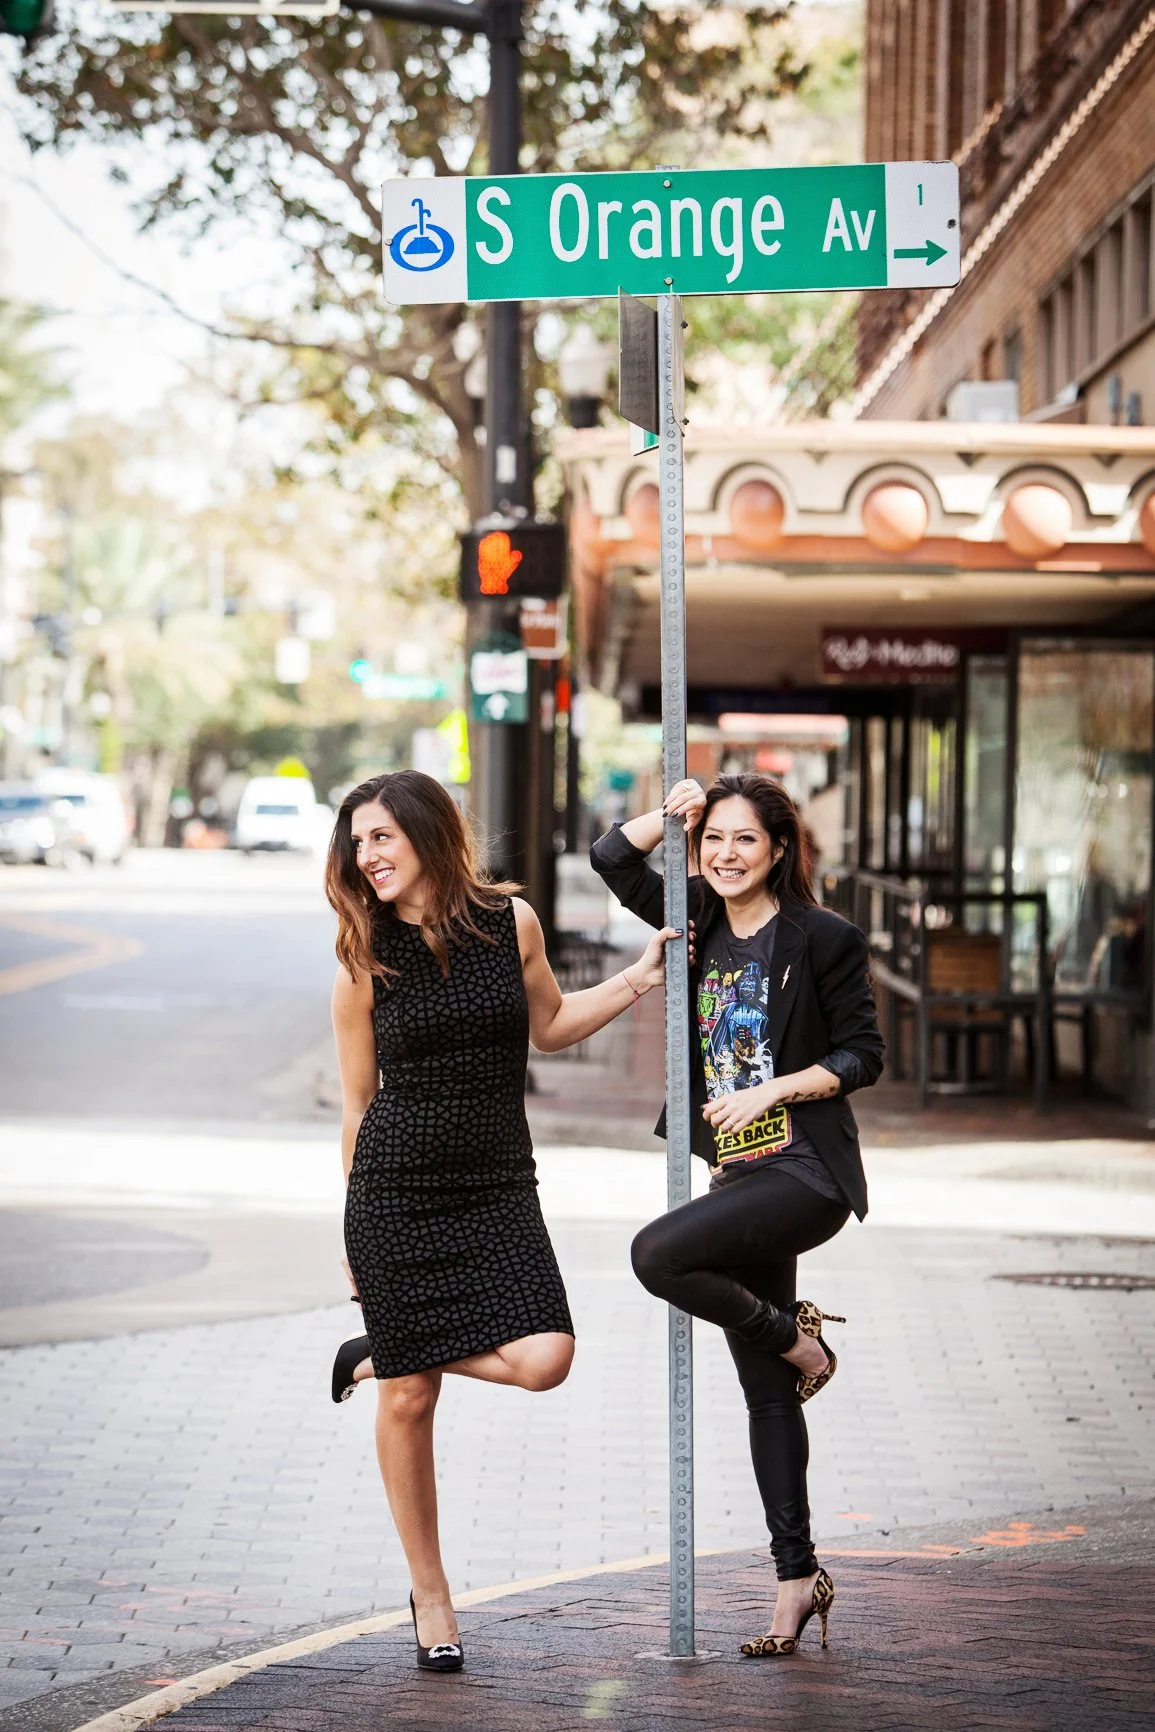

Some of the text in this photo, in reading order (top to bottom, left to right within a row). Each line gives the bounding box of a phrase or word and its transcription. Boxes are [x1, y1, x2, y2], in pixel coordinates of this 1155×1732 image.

[475, 182, 876, 284] S Orange Av
[743, 1119, 785, 1144] BACK
